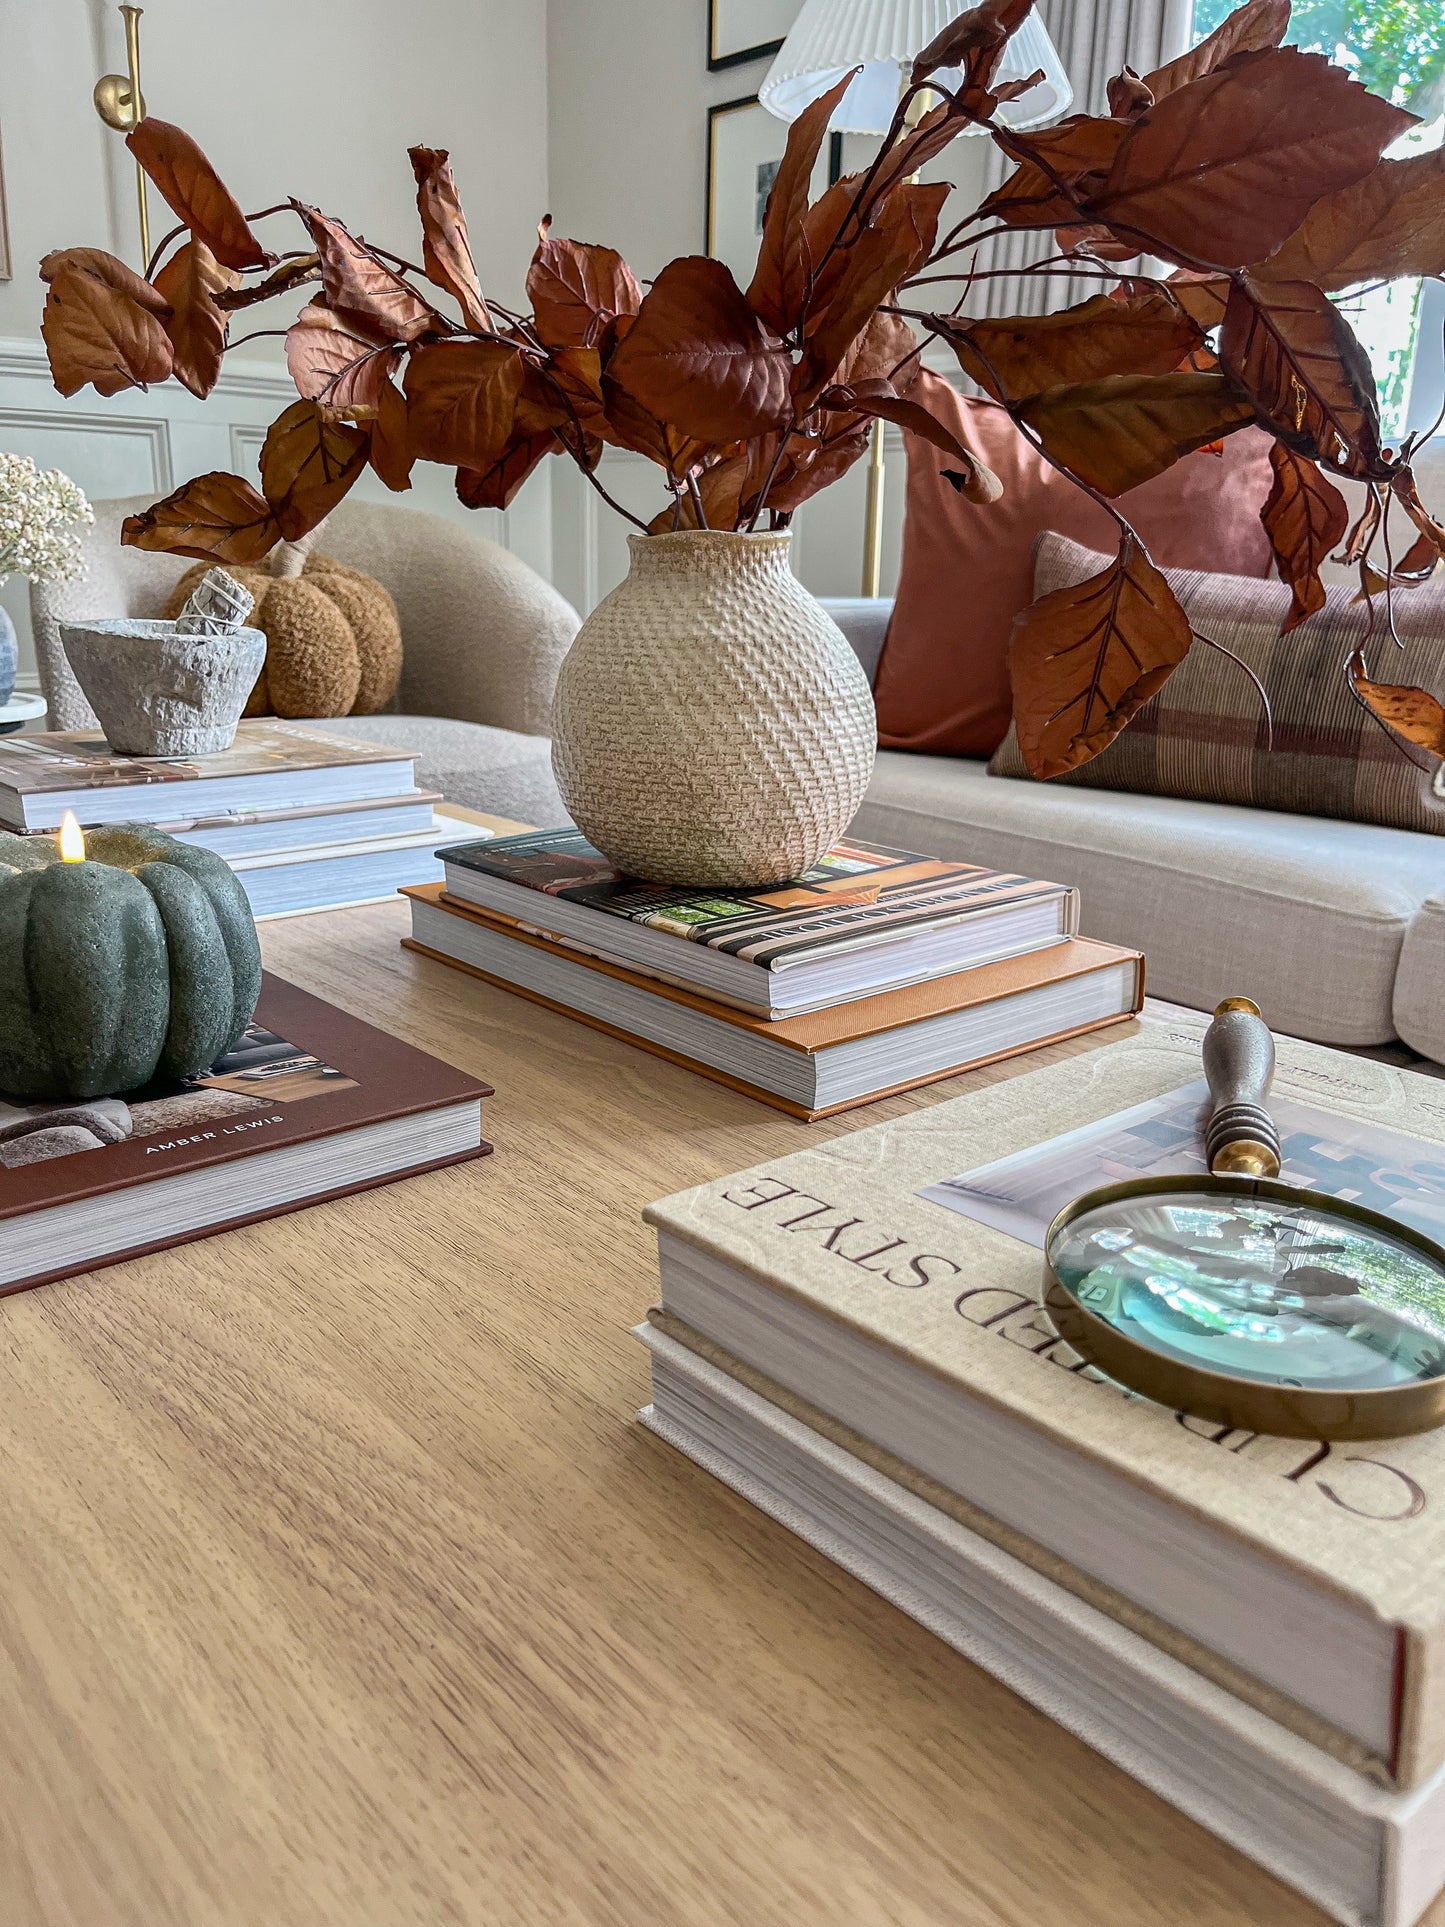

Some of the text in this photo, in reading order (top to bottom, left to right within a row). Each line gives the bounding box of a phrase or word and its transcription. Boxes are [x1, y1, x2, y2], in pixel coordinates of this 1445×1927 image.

[753, 917, 848, 941] HOME
[851, 906, 890, 922] OF
[145, 1115, 285, 1155] AMBER LEWIS
[720, 1176, 962, 1290] STYLE
